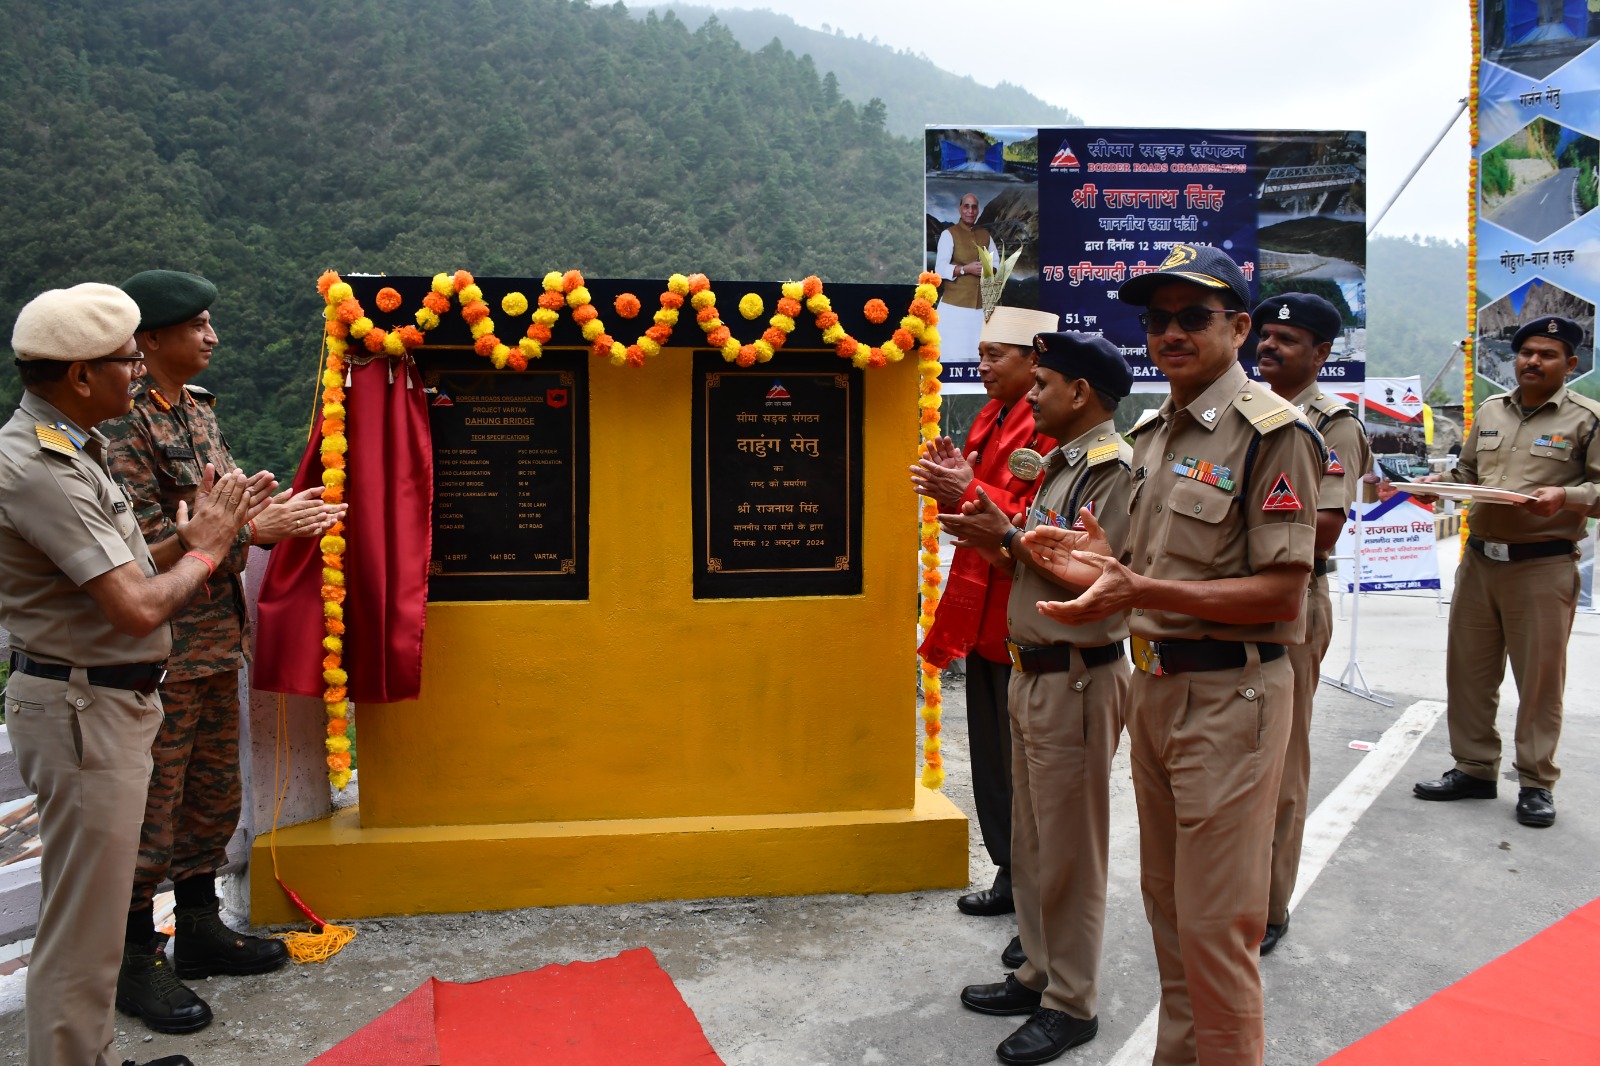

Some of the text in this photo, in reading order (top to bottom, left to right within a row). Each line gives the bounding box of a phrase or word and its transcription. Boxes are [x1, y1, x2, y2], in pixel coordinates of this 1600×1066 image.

[1546, 85, 1561, 110] सेतु
[1087, 138, 1246, 161] सीमा सड़क संगठन
[1087, 163, 1131, 173] BORDER
[1133, 163, 1169, 173] ROADS
[1170, 163, 1247, 173] ORGANISATION
[1071, 183, 1225, 212] श्री राजनाथ सिंह
[1099, 214, 1198, 231] माननीय रक्षा मंत्री
[1085, 241, 1104, 251] द्वारा
[1138, 241, 1149, 250] 12
[1553, 250, 1575, 269] सड़क
[1043, 266, 1064, 282] 75
[1068, 261, 1126, 286] बुनियादी
[1065, 313, 1097, 326] 51 पुल
[949, 367, 963, 377] IN
[1132, 366, 1158, 377] EAT
[465, 417, 535, 425] DAHUNG BRIDGE
[736, 412, 820, 425] सीमा सड़क संगठन
[736, 433, 820, 457] दाहुंग सेतु
[769, 479, 779, 487] को
[783, 479, 806, 487] समर्पण
[737, 502, 819, 513] श्री राजनाथ सिंह
[733, 523, 760, 531] माननीय
[781, 523, 794, 531] मंत्री
[797, 522, 806, 530] के
[809, 523, 823, 532] द्वारा
[1365, 525, 1408, 536] राजनाथ
[1411, 521, 1433, 534] सिंह
[733, 538, 756, 547] दिनांक
